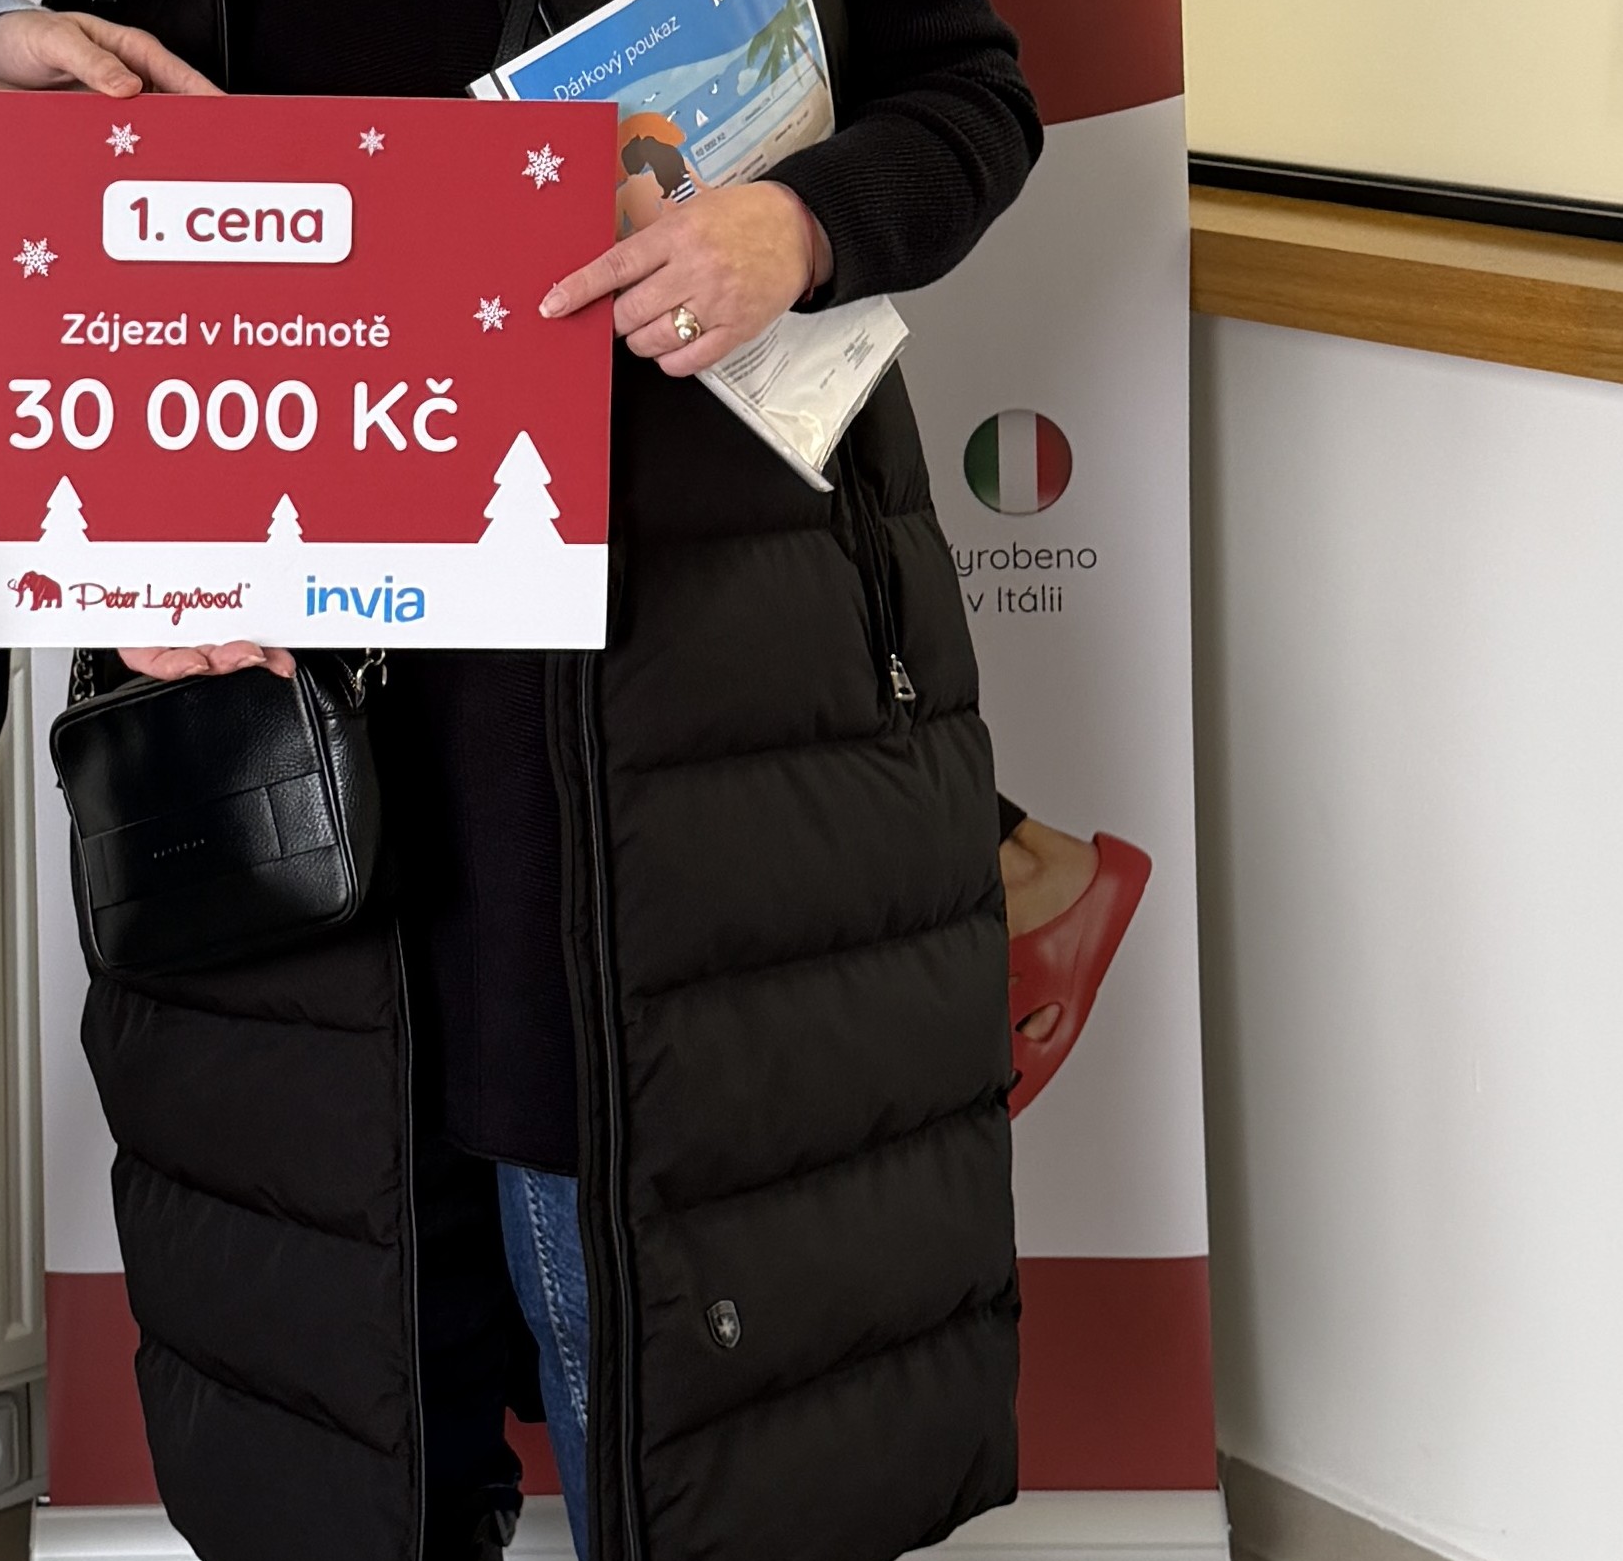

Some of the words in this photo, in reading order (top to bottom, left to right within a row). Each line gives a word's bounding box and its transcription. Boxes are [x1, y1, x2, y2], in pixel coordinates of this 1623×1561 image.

[553, 50, 623, 102] Dárkový
[624, 15, 681, 67] poukaz
[129, 196, 165, 242] 1.
[185, 207, 324, 244] cena
[60, 311, 188, 353] Zájezd
[199, 321, 222, 346] v
[233, 313, 391, 348] hodnotě
[8, 378, 114, 450] 30
[146, 378, 318, 452] 000
[353, 377, 458, 453] Kč
[948, 541, 1097, 577] yrobeno
[68, 582, 140, 611] Peter
[306, 575, 425, 624] invia
[966, 592, 985, 613] v
[997, 583, 1062, 614] Itálii
